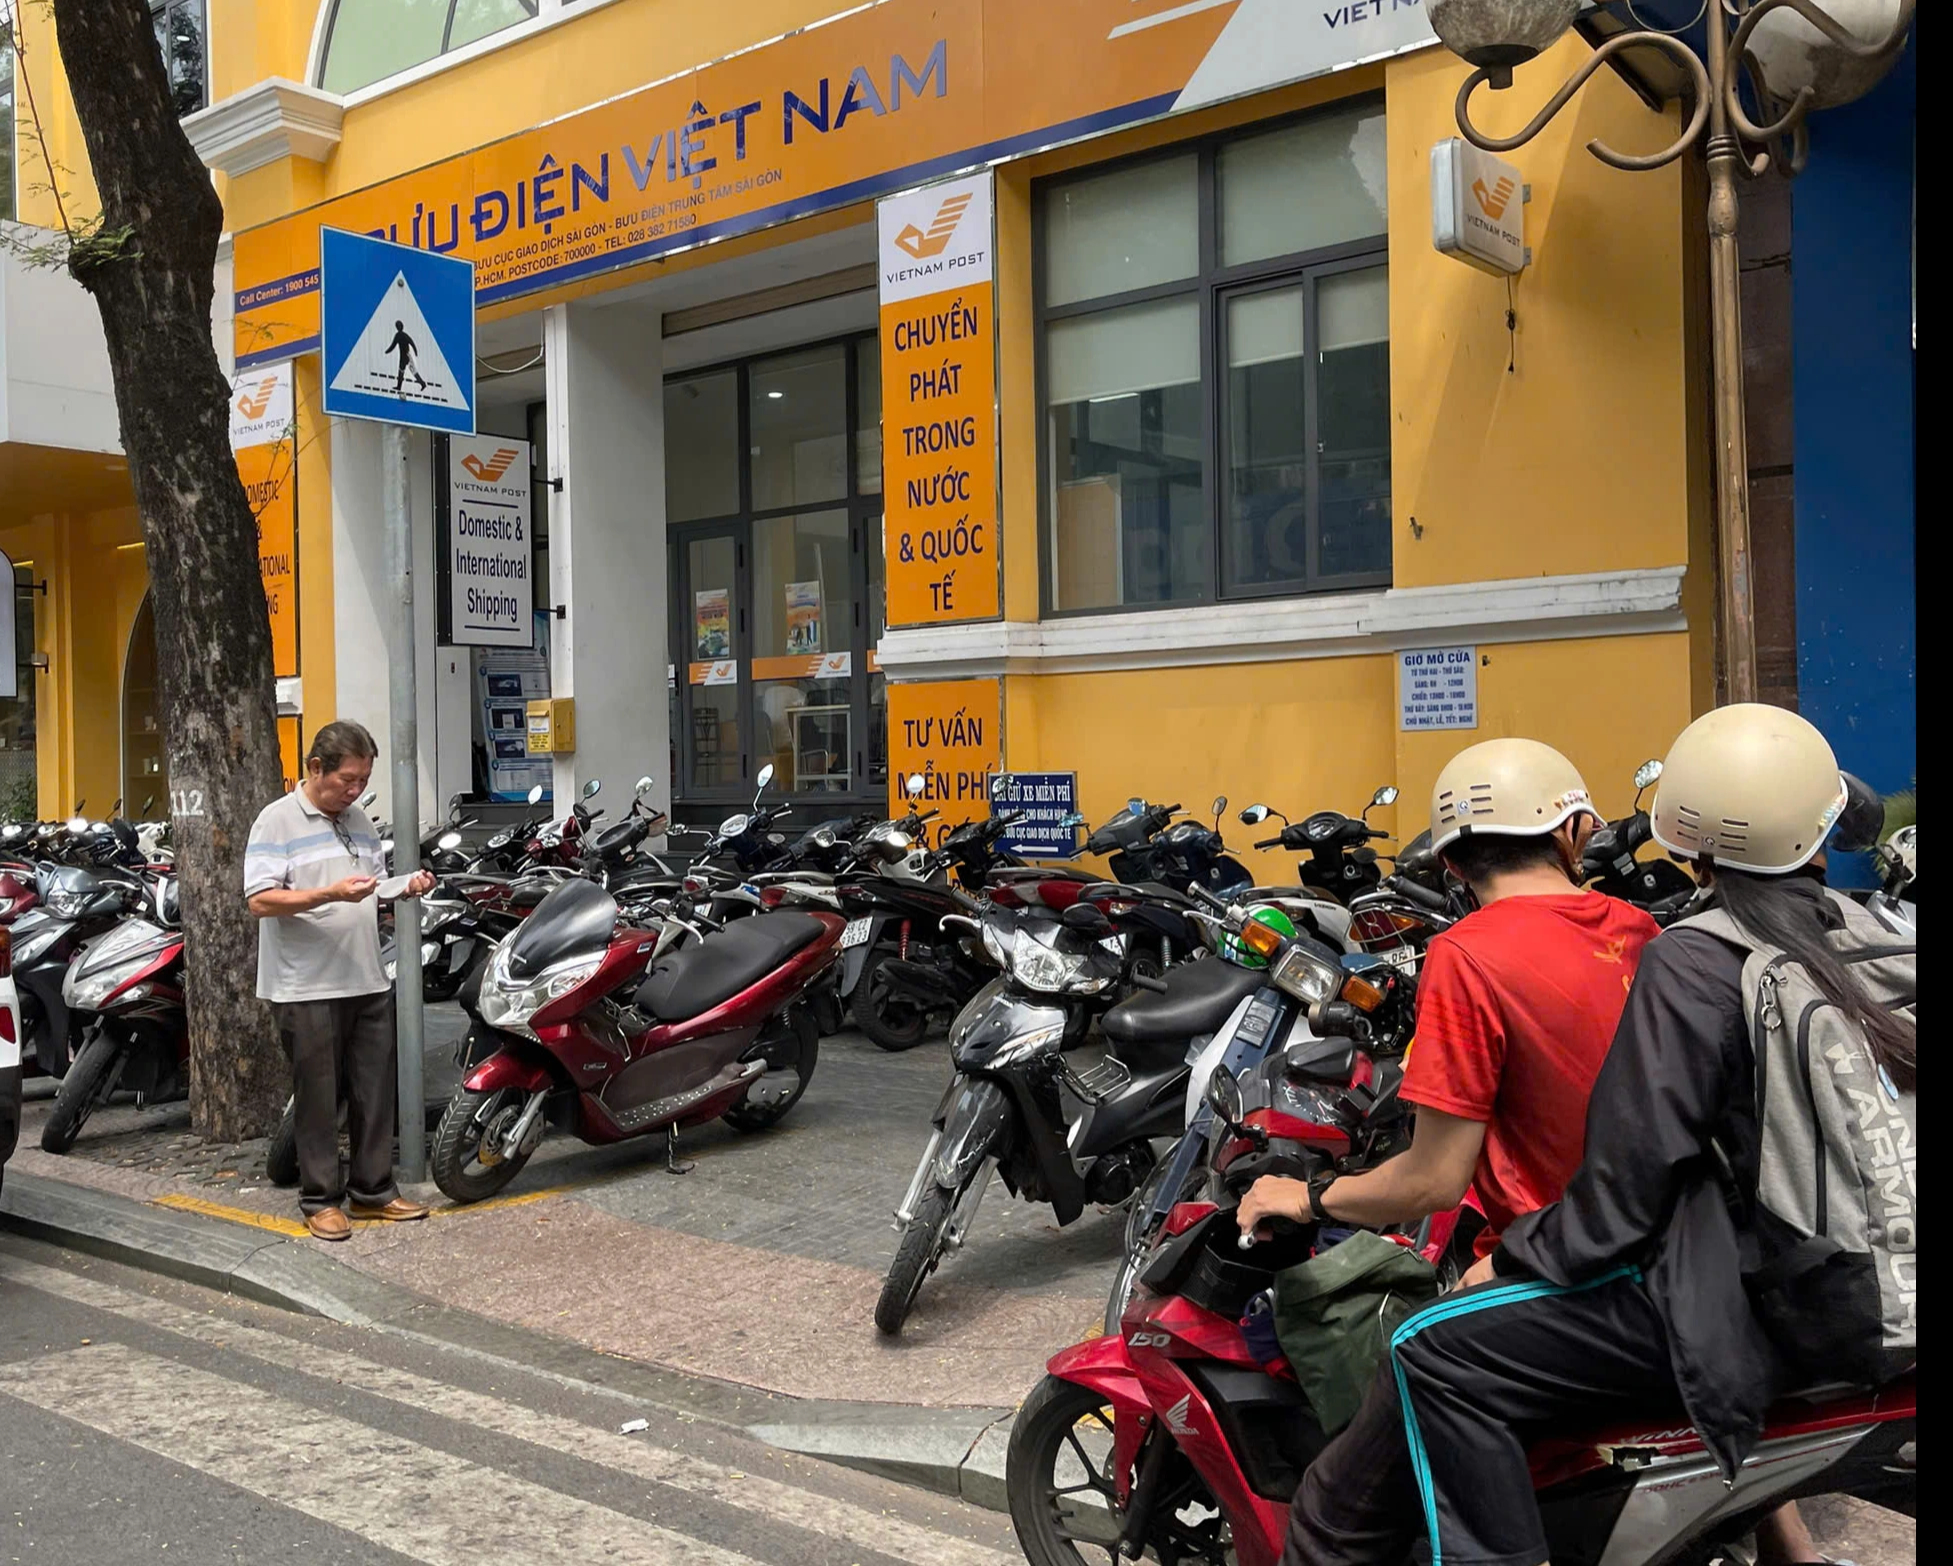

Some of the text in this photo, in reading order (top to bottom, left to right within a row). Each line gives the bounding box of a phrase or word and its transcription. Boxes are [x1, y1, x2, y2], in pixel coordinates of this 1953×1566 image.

[469, 152, 610, 242] ĐIỆN
[621, 100, 761, 191] VIỆT
[783, 38, 948, 146] NAM
[516, 242, 539, 260] GIAO
[668, 193, 706, 213] TRUNG
[1467, 214, 1521, 247] VIETNAM POST
[508, 256, 562, 279] POSTCODE:
[564, 242, 596, 263] 700000
[604, 235, 626, 250] TEL:
[627, 227, 646, 244] 028
[647, 221, 666, 238] 382
[886, 251, 985, 284] VIETNAM POST
[240, 293, 255, 306] Call
[256, 286, 284, 301] Center:
[285, 279, 304, 292] 1900
[894, 297, 978, 351] CHUYỂN
[910, 358, 962, 402] PHÁT
[233, 418, 285, 436] VIETNAM POST
[903, 416, 975, 456] TRONG
[246, 479, 279, 505] OMESTIC
[454, 482, 527, 497] VIETNAM POST
[907, 465, 970, 509] NƯỚC
[458, 509, 523, 541] Domestic &
[899, 514, 984, 563] & QUỐC
[456, 548, 527, 580] International
[467, 587, 517, 623] Shipping
[929, 569, 956, 611] TẾ
[1404, 653, 1423, 666] GIỜ
[904, 706, 982, 748] TƯ VẤN
[898, 760, 949, 800] MỄN
[1023, 785, 1034, 801] XE
[1128, 1332, 1171, 1347] 150
